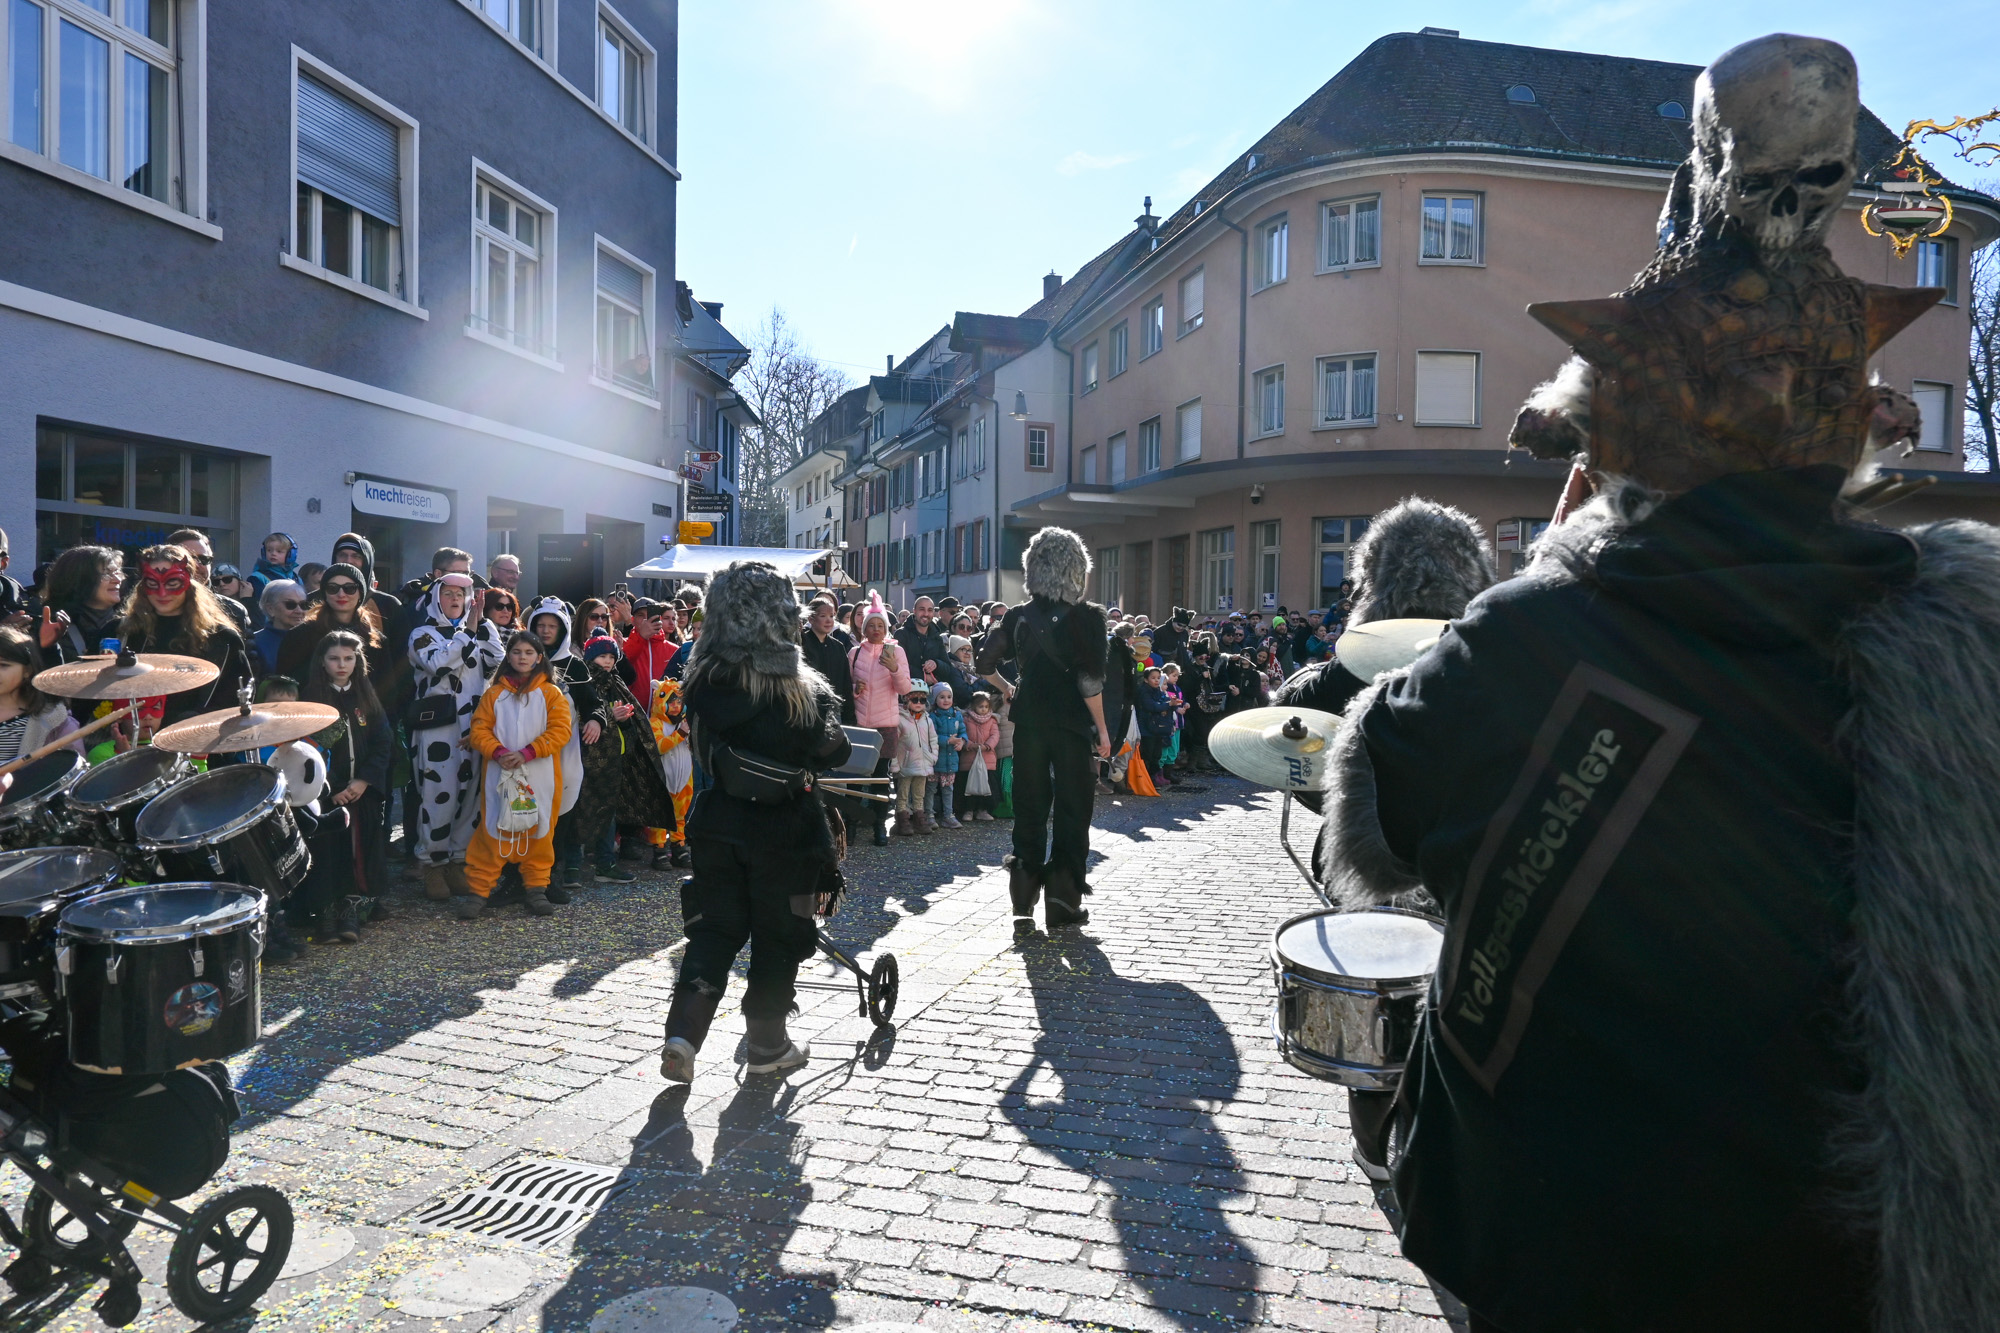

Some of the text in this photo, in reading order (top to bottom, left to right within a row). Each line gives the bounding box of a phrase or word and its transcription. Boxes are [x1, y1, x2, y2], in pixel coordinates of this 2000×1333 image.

[365, 482, 432, 508] knechtreisen
[411, 509, 419, 517] der
[1458, 727, 1622, 1026] Vollgashöckler
